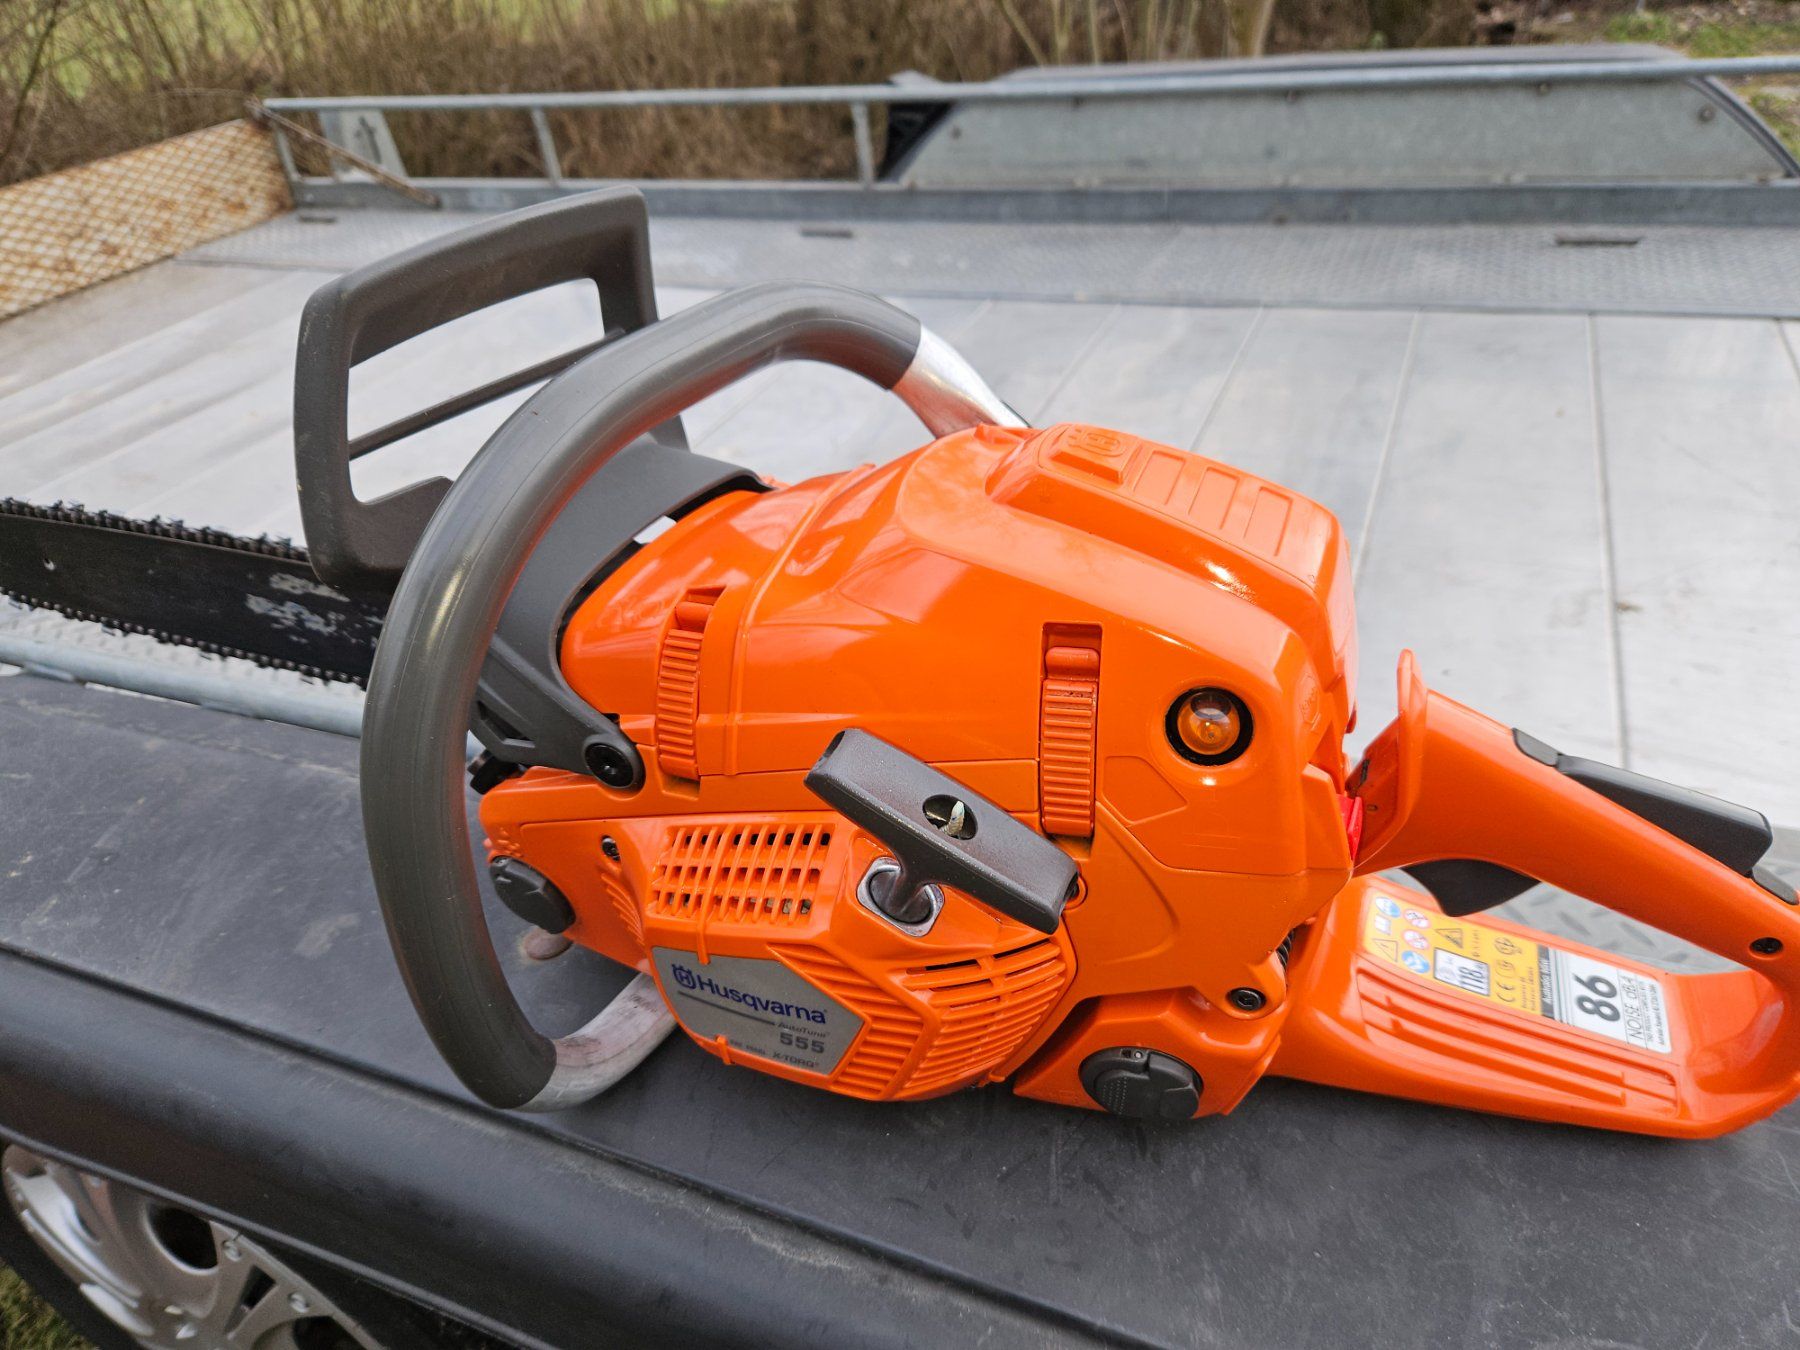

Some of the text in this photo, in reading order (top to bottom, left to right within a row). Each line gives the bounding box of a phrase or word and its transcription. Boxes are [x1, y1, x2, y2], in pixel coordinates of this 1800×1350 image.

[698, 974, 826, 1024] Husqvarna
[1572, 972, 1621, 1022] 86
[779, 1031, 825, 1054] 555
